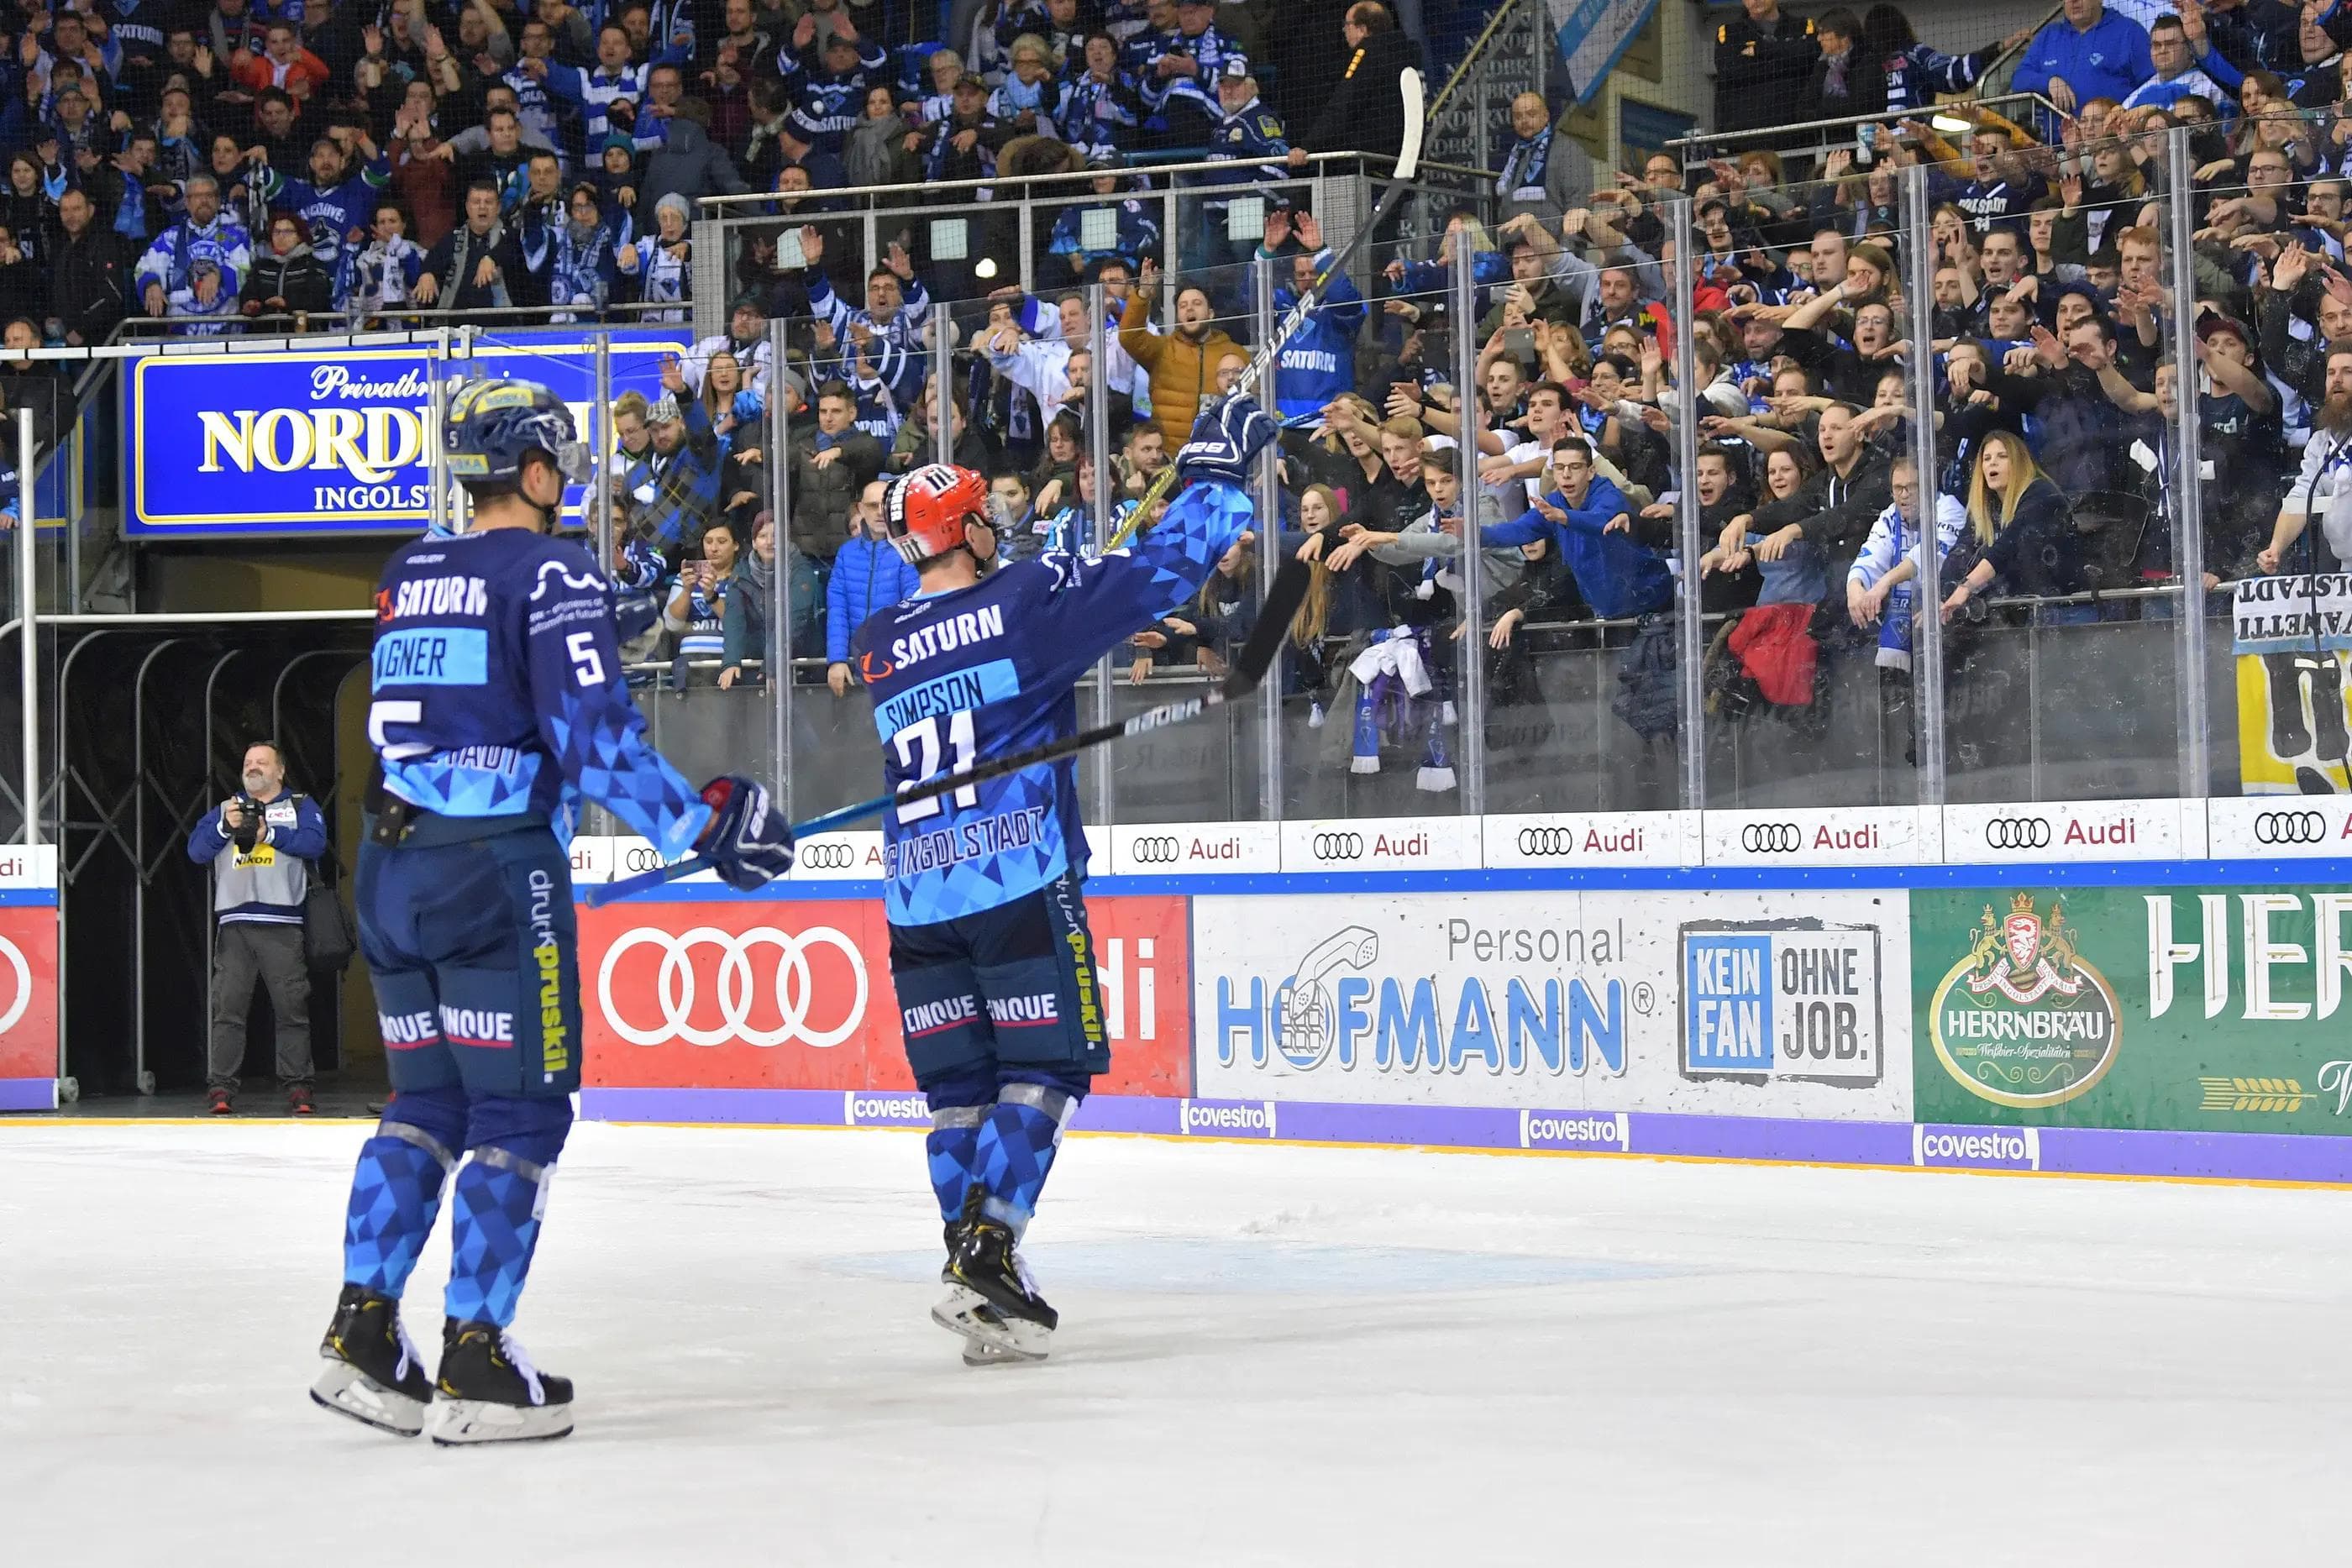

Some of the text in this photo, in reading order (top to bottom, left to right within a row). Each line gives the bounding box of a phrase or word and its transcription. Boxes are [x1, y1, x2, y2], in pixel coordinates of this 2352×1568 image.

[1280, 349, 1336, 373] SATURN
[197, 406, 436, 485] NORD
[394, 575, 487, 619] SATURN
[2239, 575, 2352, 603] LSTADT
[892, 604, 1005, 670] SATURN
[566, 632, 605, 687] 5
[886, 671, 986, 735] SIMPSON
[893, 710, 977, 825] 21
[900, 805, 1044, 878] INGOLSTADT
[1189, 836, 1240, 859] Audi
[1373, 833, 1429, 856] Audi
[1583, 827, 1644, 852] Audi
[1814, 823, 1879, 849] Audi
[2064, 819, 2135, 845] Audi
[0, 858, 23, 876] di
[234, 854, 273, 867] Nikon
[570, 851, 591, 869] di
[1448, 918, 1625, 963] Personal
[1697, 948, 1761, 995] KEIN
[1781, 947, 1859, 995] OHNE
[1096, 938, 1156, 1041] di
[904, 994, 978, 1033] CINQUE
[1698, 1000, 1761, 1057] FAN
[1782, 1000, 1868, 1060] JOB.
[1948, 1010, 2104, 1041] HERRNBRÄU
[1188, 1103, 1263, 1130] covestro
[1529, 1118, 1618, 1143] covestro
[1924, 1130, 2025, 1161] covestro
